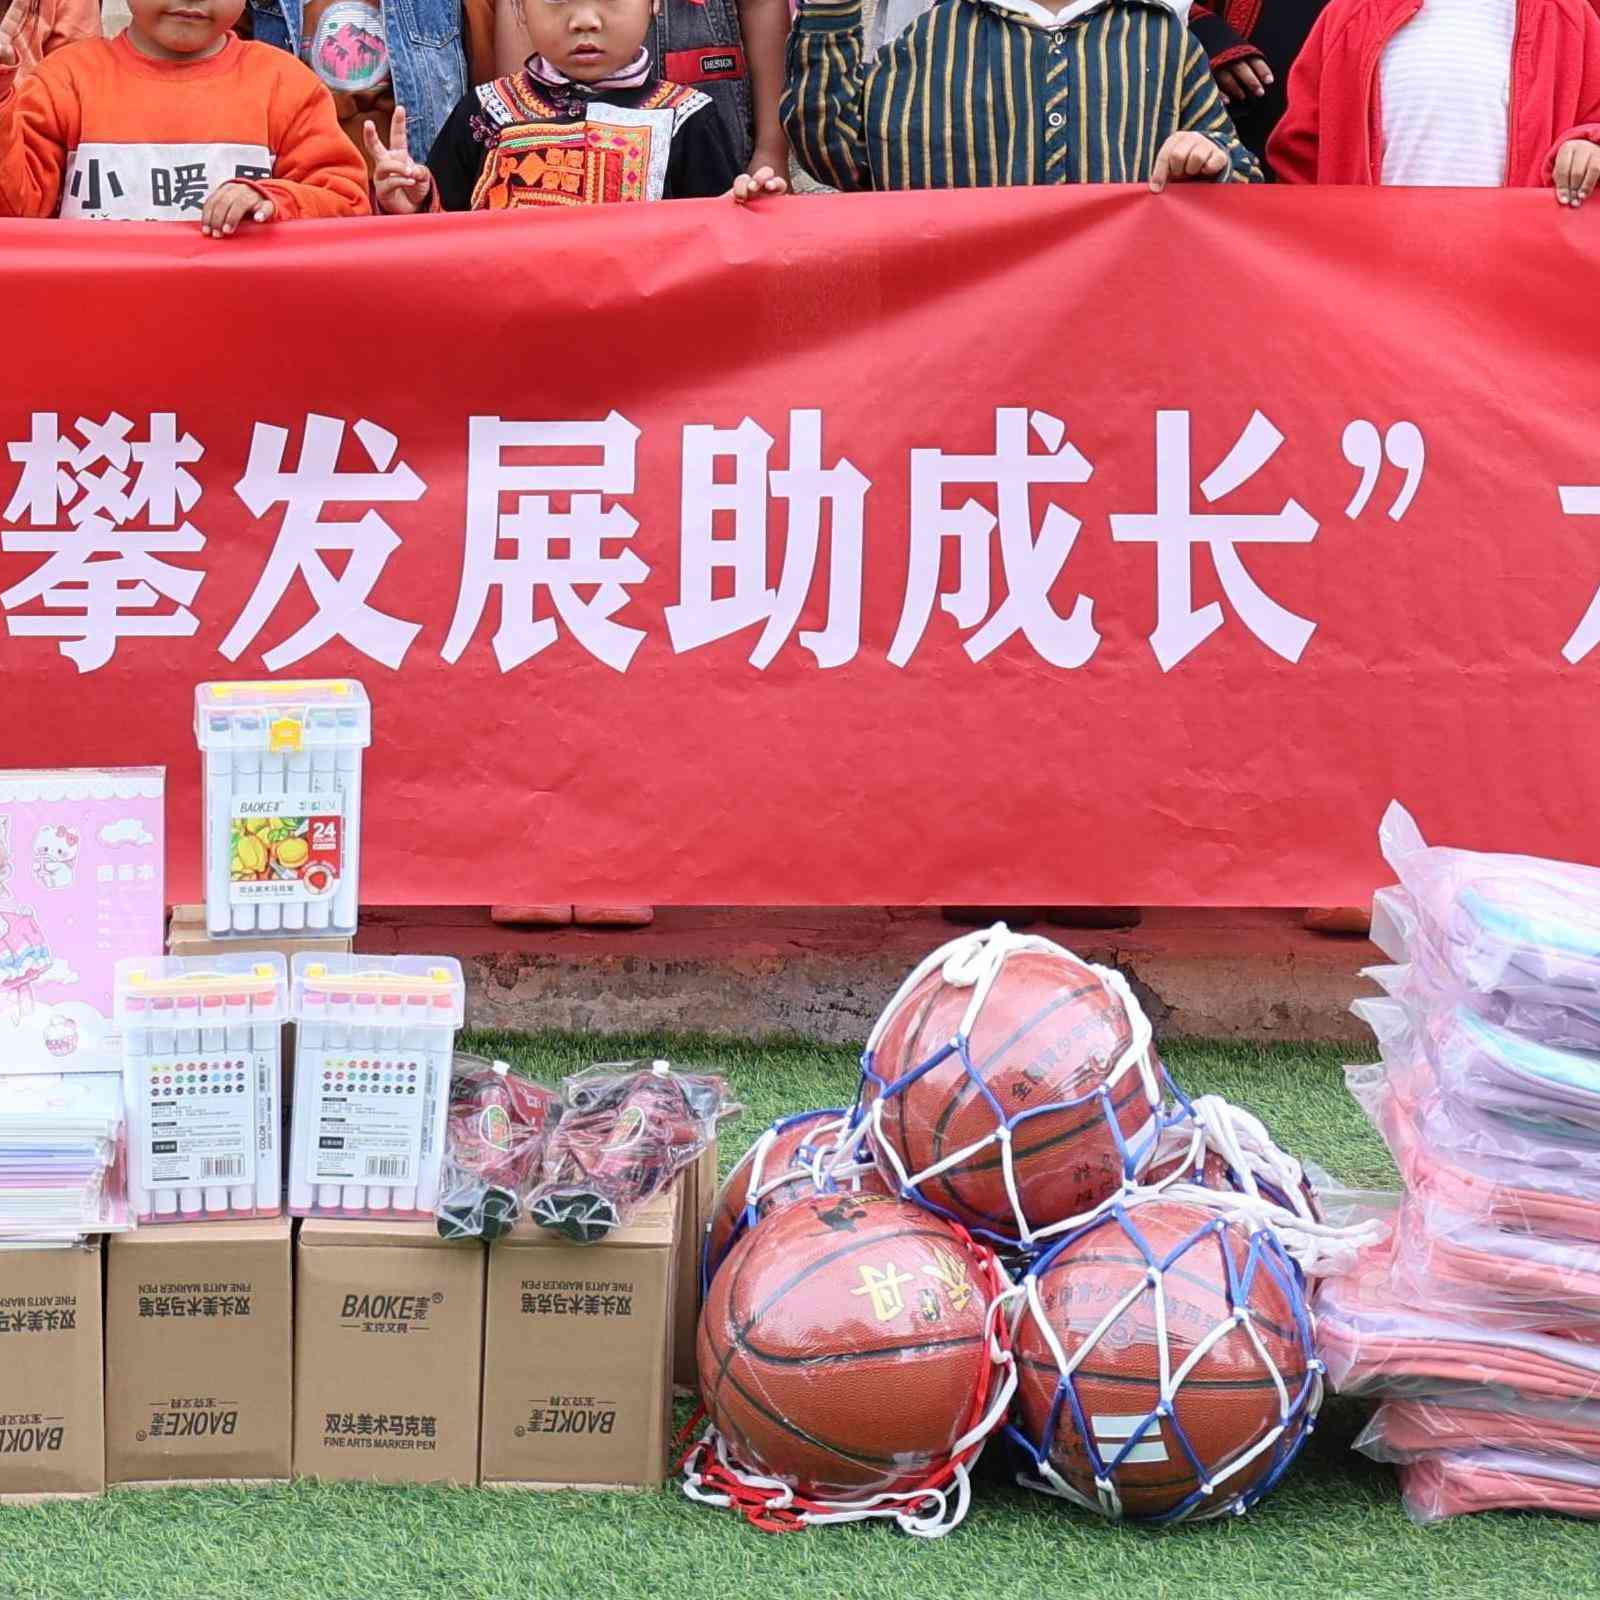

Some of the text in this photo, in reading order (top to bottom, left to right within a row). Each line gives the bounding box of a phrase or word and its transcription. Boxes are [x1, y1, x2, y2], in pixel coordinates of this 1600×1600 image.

[313, 823, 337, 838] 24
[138, 1283, 251, 1294] FINE ARTS MARKER PEN
[521, 1280, 633, 1291] FINE ARTS MARKER PEN
[27, 1296, 53, 1306] ARTS
[55, 1296, 76, 1305] FINE
[138, 1296, 250, 1317] 双头美术马克笔
[341, 1294, 414, 1320] BAOKE
[521, 1292, 632, 1315] 双头美术马克笔
[362, 1322, 408, 1334] 宝克文具
[165, 1412, 238, 1435] BAOKE
[325, 1414, 437, 1437] 双头美术马克笔
[543, 1409, 616, 1434] BAOKE
[324, 1437, 436, 1450] FINE ARTS MARKER PEN
